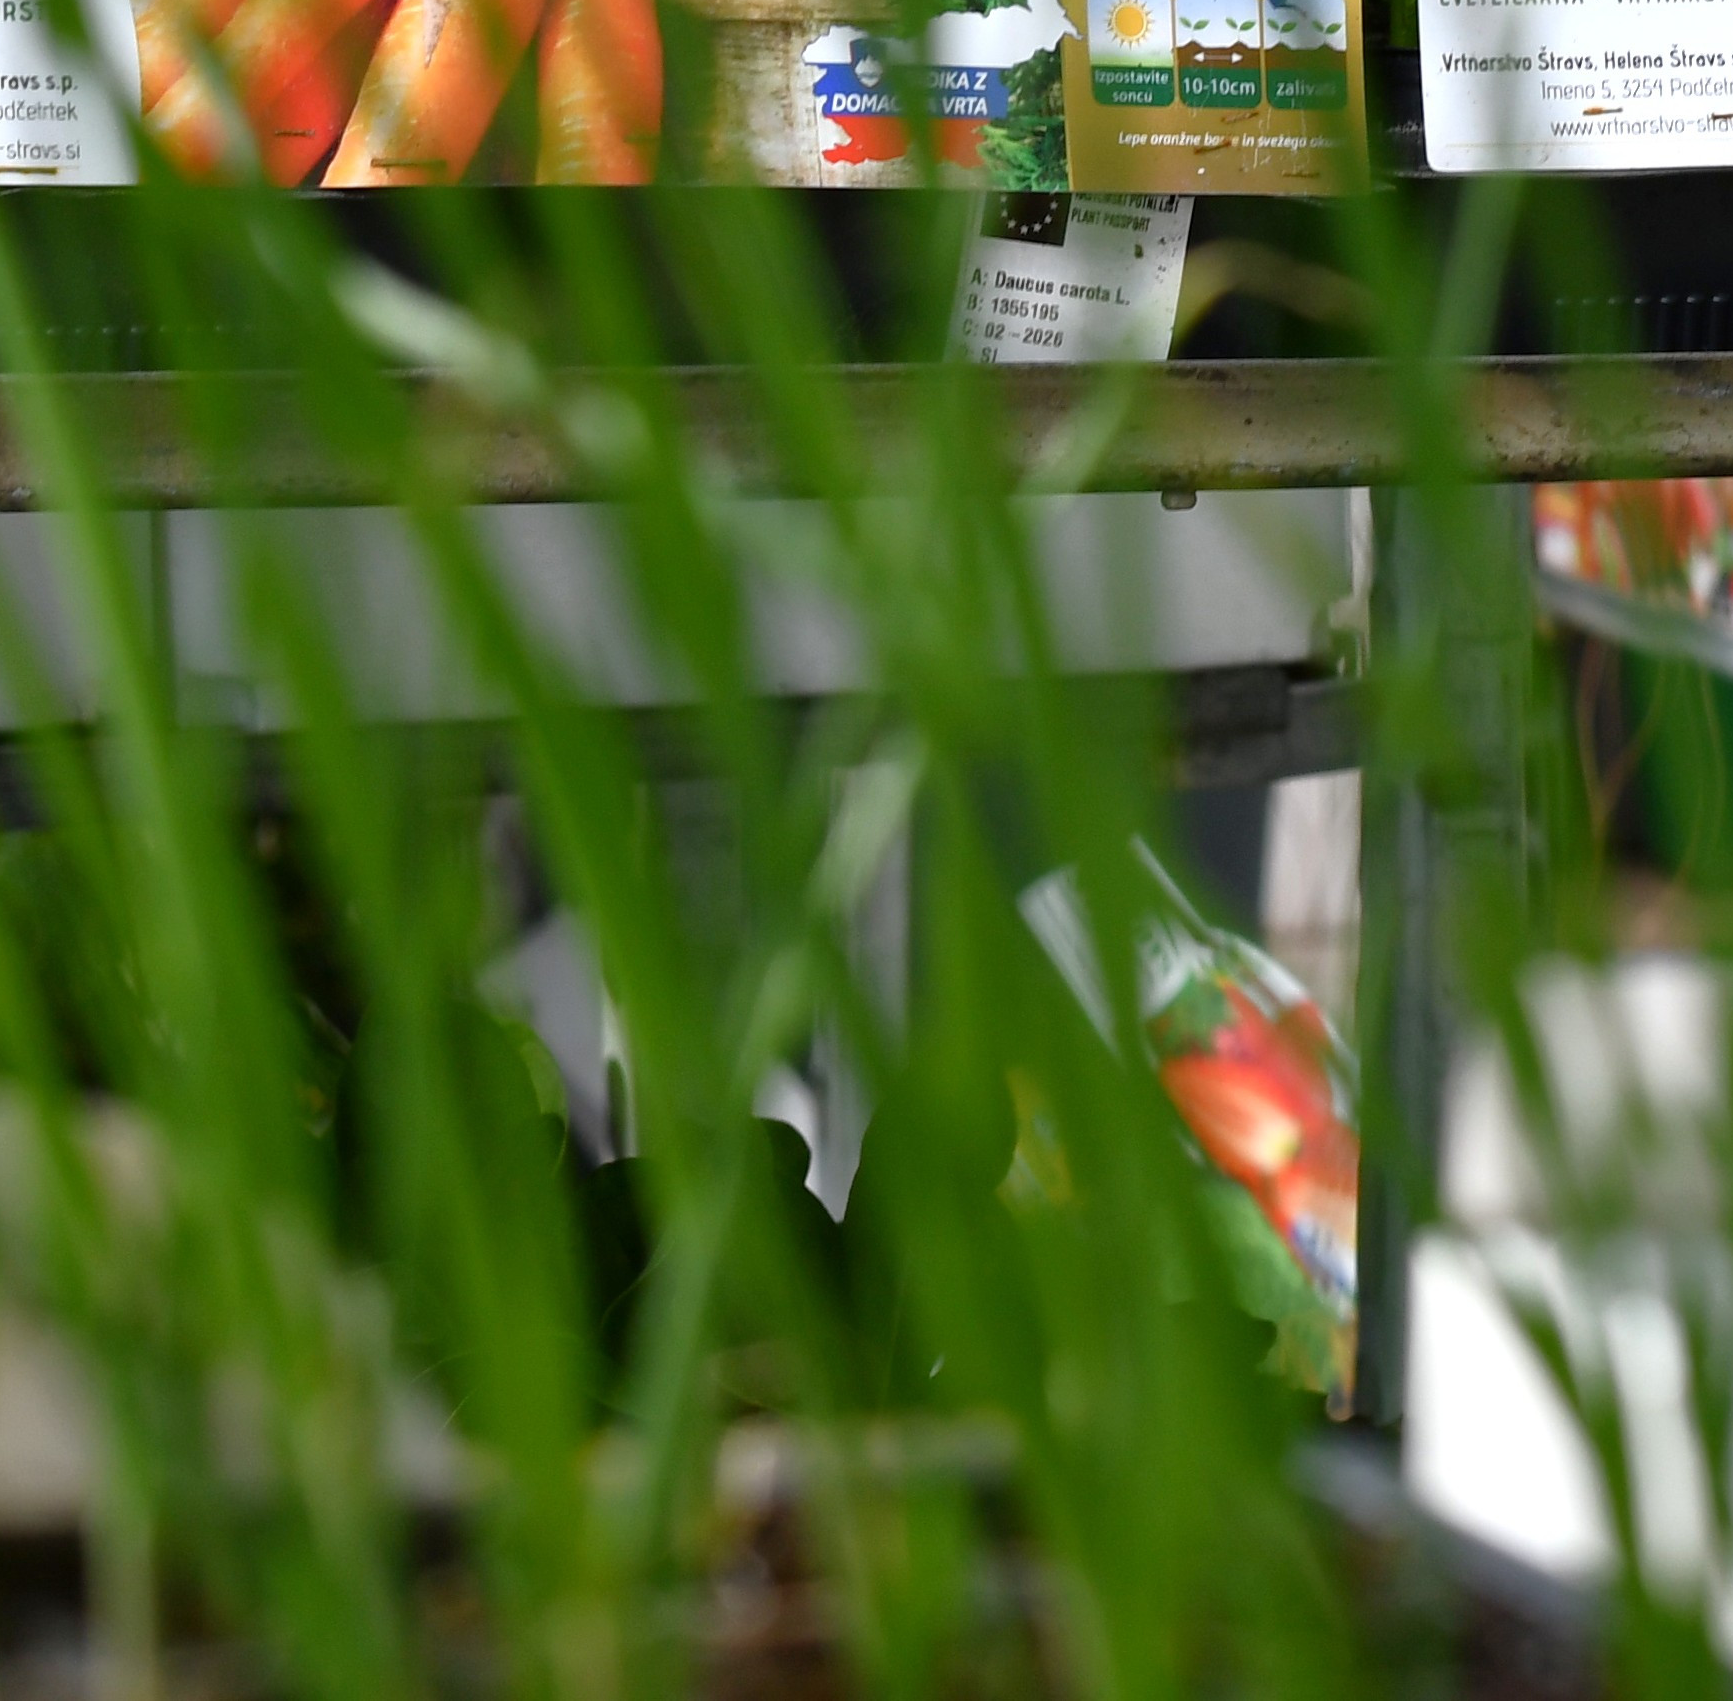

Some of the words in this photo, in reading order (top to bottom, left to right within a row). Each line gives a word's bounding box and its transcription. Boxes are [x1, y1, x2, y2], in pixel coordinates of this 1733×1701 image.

[1442, 52, 1532, 72] Vrtnarstvo
[1537, 46, 1598, 72] Štravs,
[1604, 51, 1664, 70] Helena
[1670, 45, 1725, 69] Štravs
[44, 74, 79, 95] s.p.
[973, 72, 988, 91] Z
[1183, 77, 1256, 96] 10-10cm
[1542, 81, 1595, 100] Imeno
[1622, 78, 1664, 98] 3254
[942, 96, 988, 116] VRTA
[1118, 131, 1147, 147] Lepe
[1150, 130, 1200, 147] oranžne
[1242, 133, 1254, 147] in
[971, 268, 988, 286] A:
[994, 271, 1054, 295] Daucus
[1059, 284, 1110, 303] carota
[1115, 287, 1130, 306] L.
